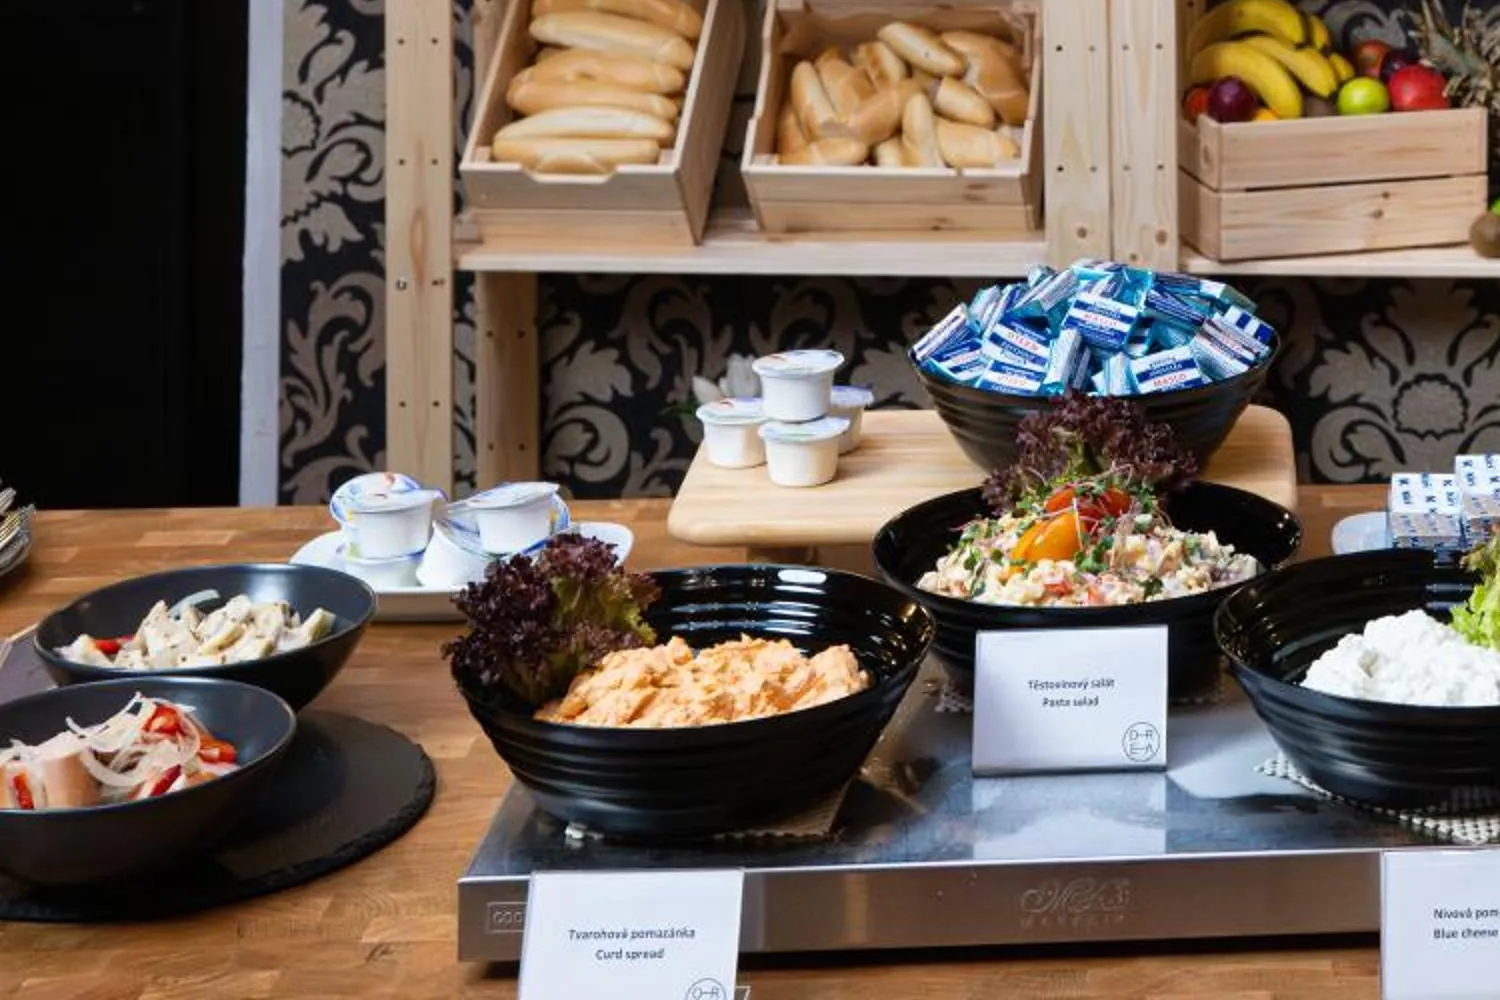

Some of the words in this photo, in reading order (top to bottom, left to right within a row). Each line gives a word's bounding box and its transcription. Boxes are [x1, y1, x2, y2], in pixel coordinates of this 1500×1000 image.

[1042, 697, 1071, 707] Pasta
[1073, 695, 1099, 707] salad
[1433, 927, 1458, 939] Blue
[1461, 927, 1499, 939] cheese
[595, 948, 622, 960] Curd
[625, 947, 665, 961] spread
